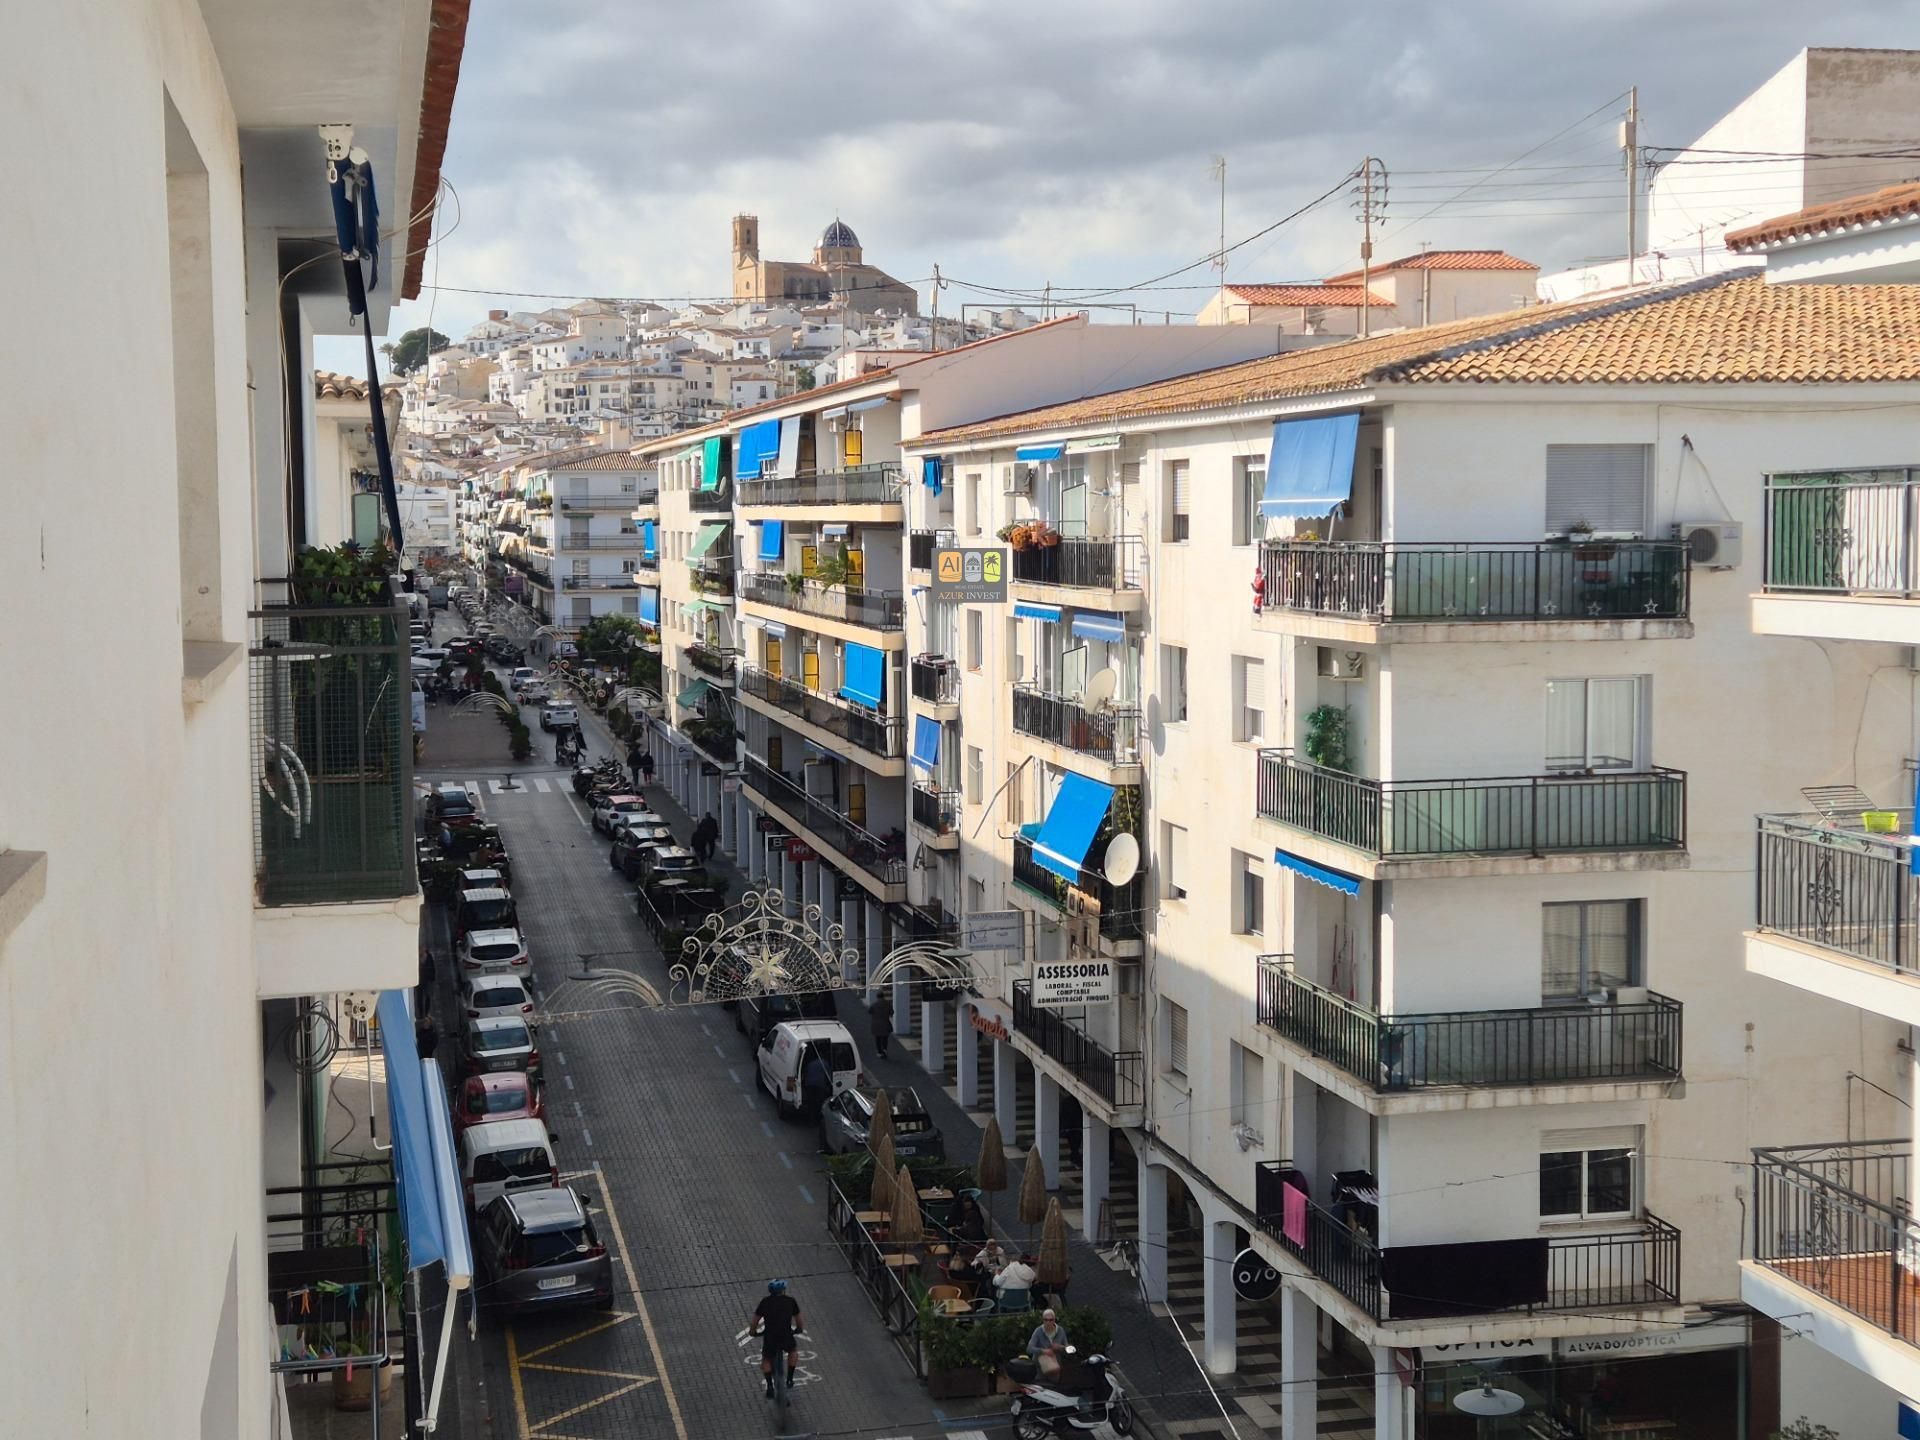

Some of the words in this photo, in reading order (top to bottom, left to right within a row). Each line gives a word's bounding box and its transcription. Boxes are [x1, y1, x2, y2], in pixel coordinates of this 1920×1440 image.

[942, 556, 960, 572] AI
[938, 591, 964, 600] AZUR
[966, 591, 1001, 600] INVEST
[1037, 963, 1110, 979] ASSESSORIA
[1045, 982, 1073, 990] LABORAL
[1086, 994, 1110, 1002] FINQUES
